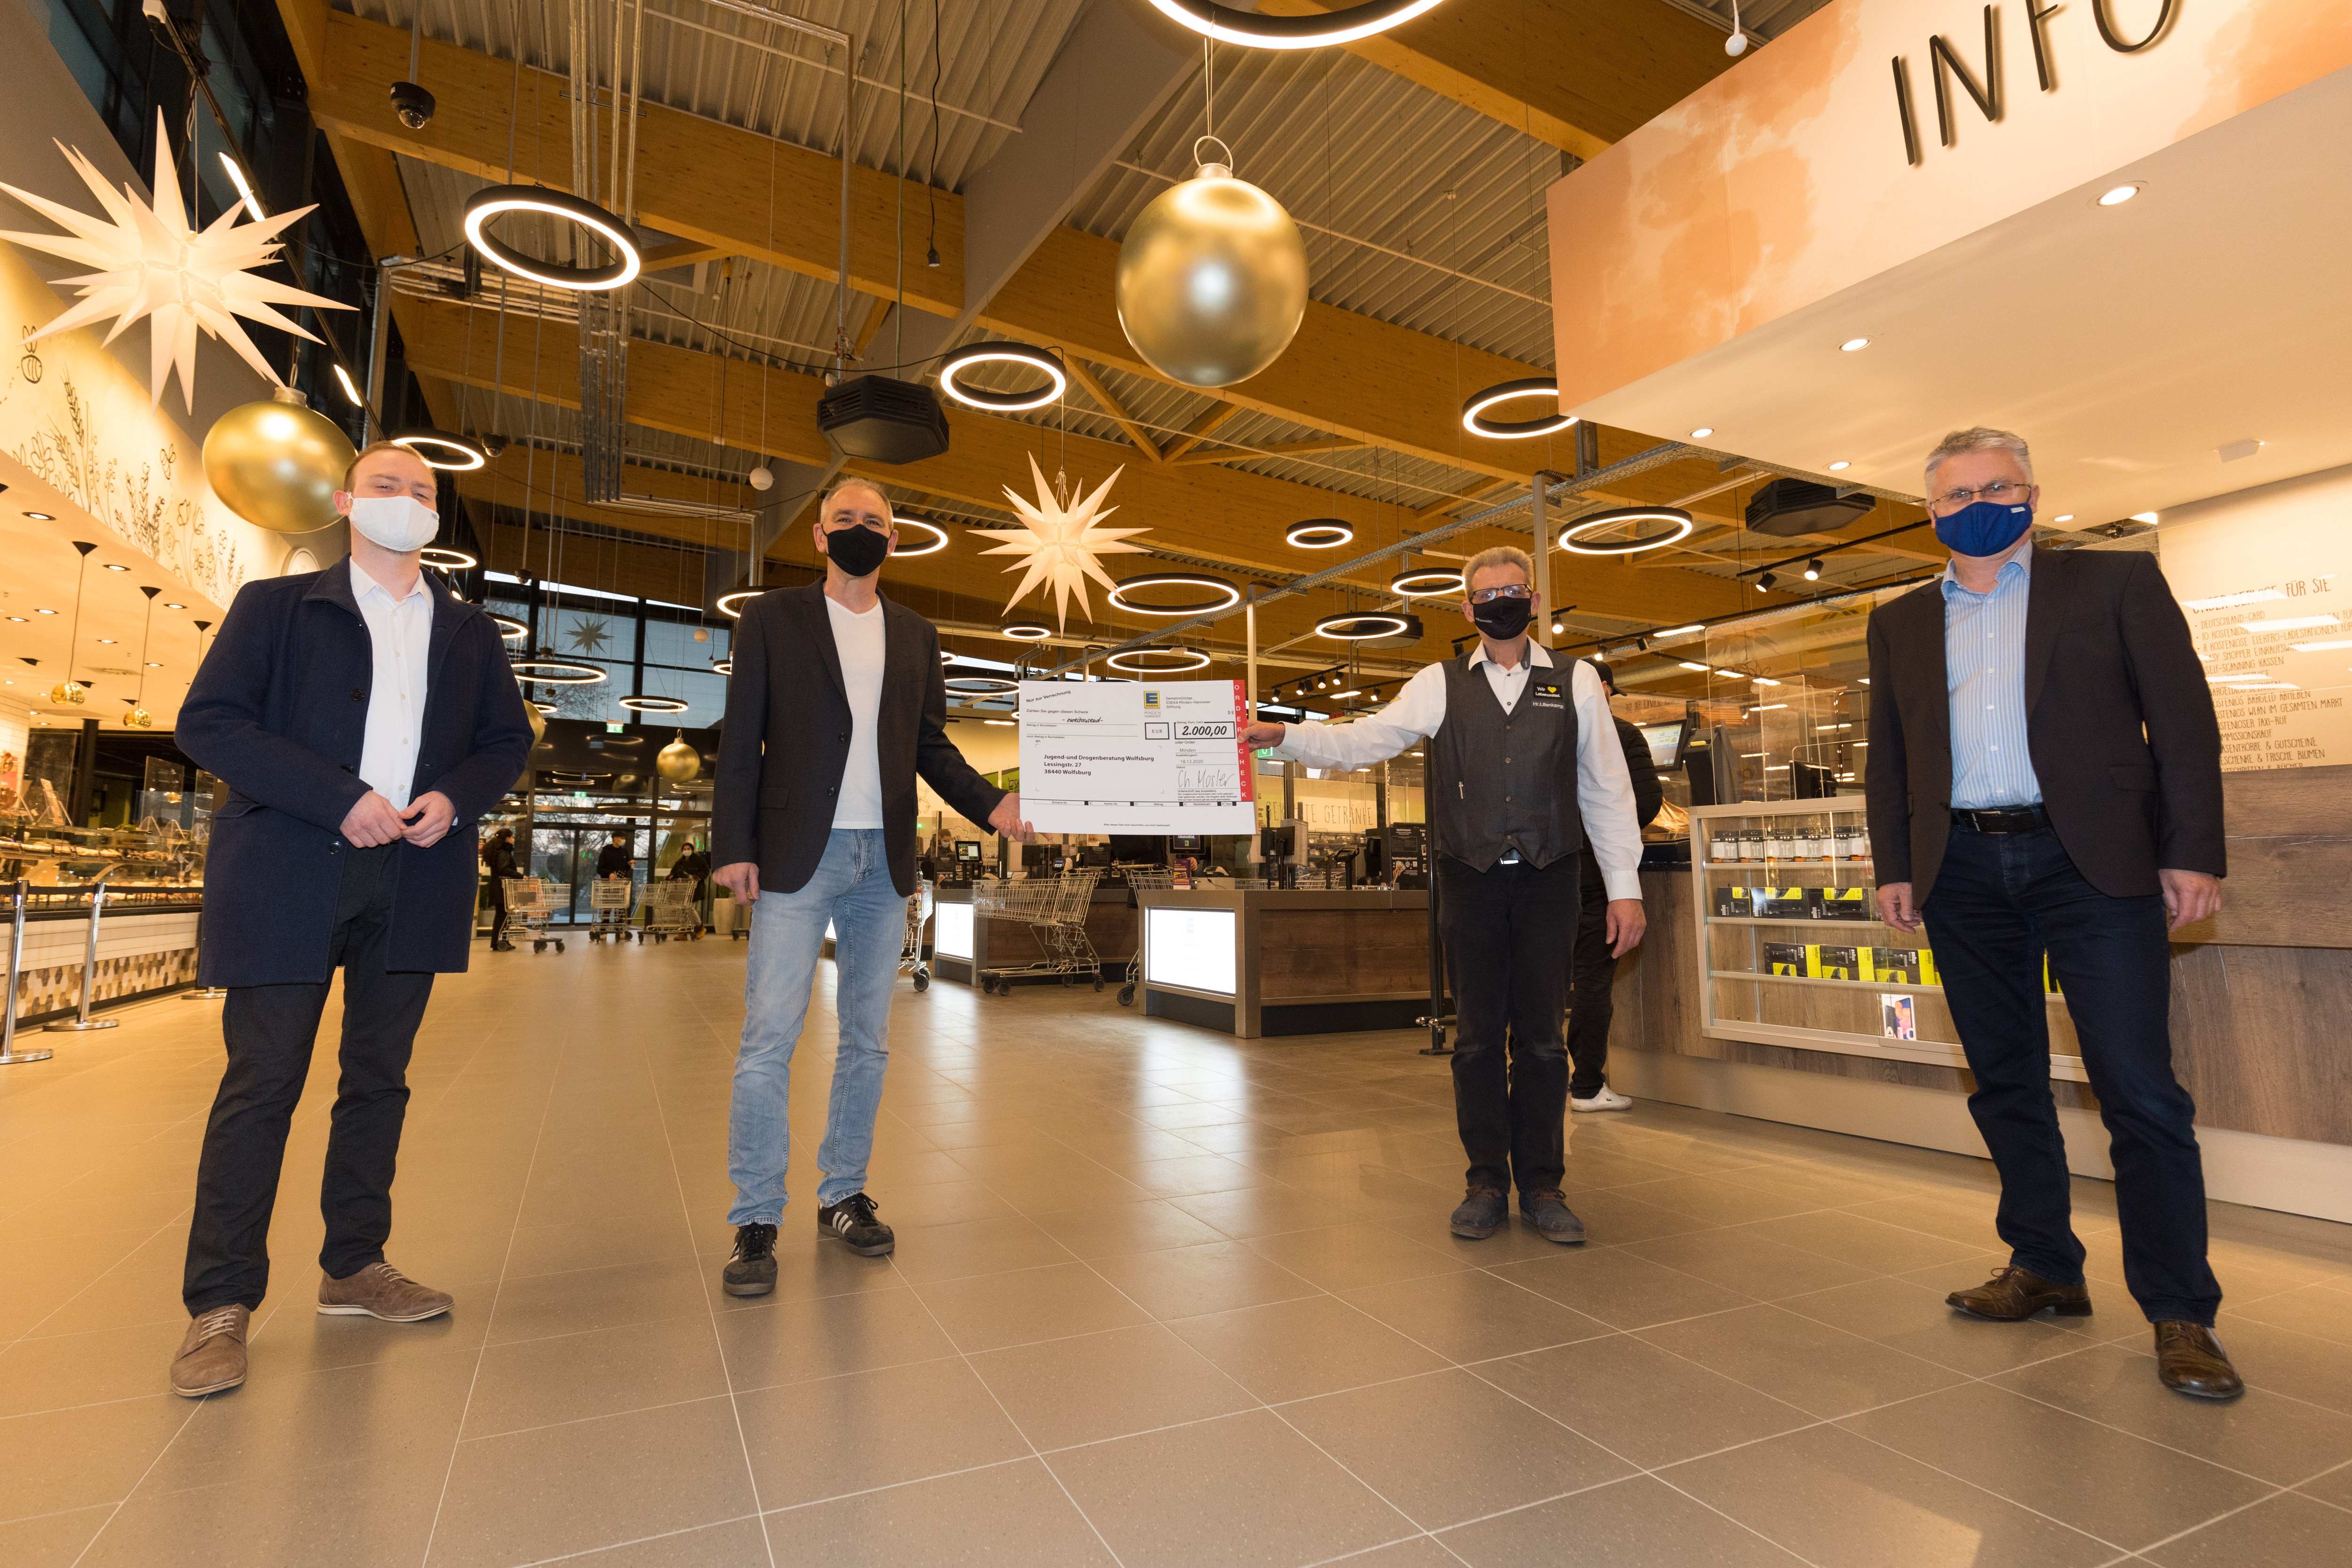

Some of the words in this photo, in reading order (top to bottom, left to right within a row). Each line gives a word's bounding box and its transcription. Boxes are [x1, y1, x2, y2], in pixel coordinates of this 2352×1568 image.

[2286, 581, 2306, 597] FÜR
[2312, 578, 2332, 593] SIE
[2201, 611, 2265, 629] DEUTSCHLAND-CARD
[2202, 632, 2209, 641] 10
[2343, 609, 2352, 620] FÜ
[2203, 643, 2208, 652] 8
[2210, 638, 2249, 651] KOSTENLOSE
[2252, 625, 2337, 645] ELEKTRO-LADESTATIONEN
[2223, 649, 2251, 661] SHOPPER
[2205, 661, 2255, 675] SELF-SCANNING
[2259, 656, 2284, 667] KASSEN
[1043, 690, 1071, 699] Verrechnung
[2212, 697, 2244, 708] OSTENLOS
[2248, 693, 2276, 704] BARGELD
[2280, 689, 2311, 701] ABHEBEN
[2215, 708, 2245, 719] OSTENLOS
[2248, 706, 2266, 716] WLAN
[2269, 705, 2277, 714] IM
[2280, 700, 2317, 713] GESAMTEN
[2320, 698, 2343, 708] MARKT
[1181, 725, 1227, 737] 2.000,00
[2217, 719, 2254, 731] OSTENLOSER
[2258, 715, 2288, 727] TAXI-RUF
[2221, 729, 2273, 741] MMISSIONSKAUF
[2221, 741, 2262, 753] ÄSENTKÖRBE
[2265, 740, 2271, 750] &
[2274, 736, 2318, 749] GUTSCHEINE
[2220, 754, 2254, 765] ESCHENKE
[2257, 754, 2263, 763] &
[2266, 751, 2294, 763] FRISCHE
[2297, 748, 2325, 760] BLUMEN
[1886, 1026, 1916, 1041] A10
